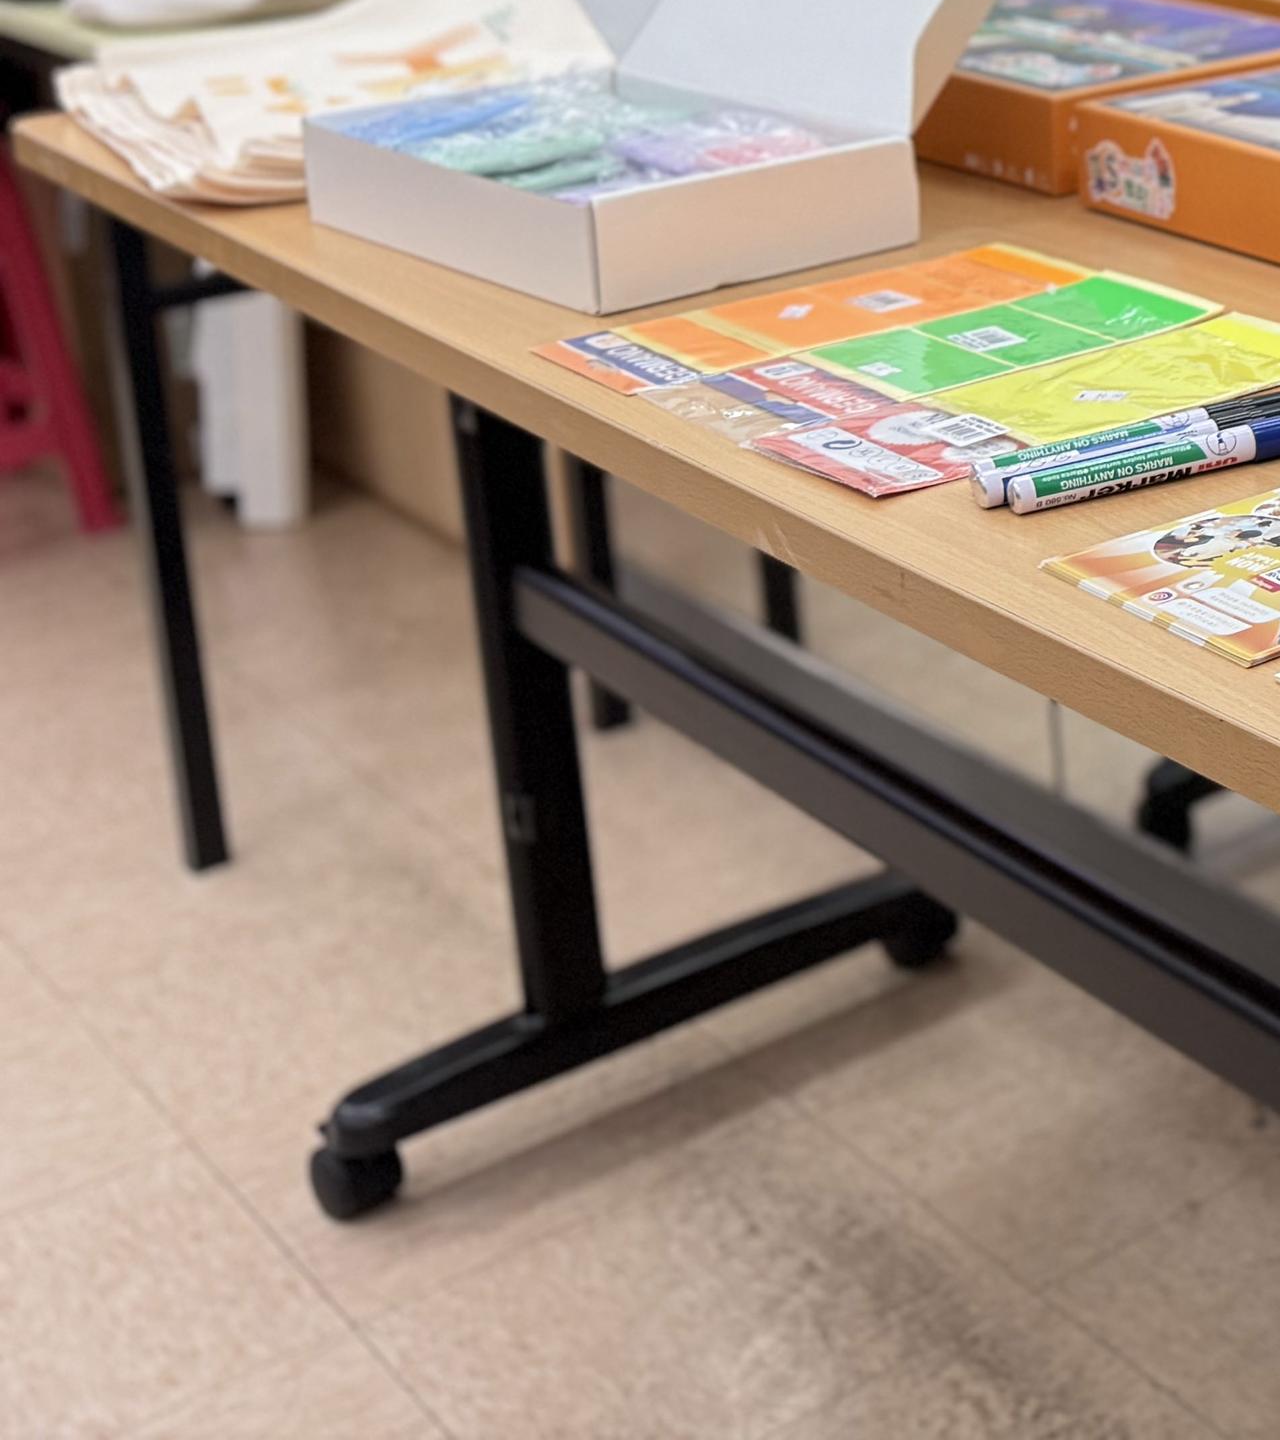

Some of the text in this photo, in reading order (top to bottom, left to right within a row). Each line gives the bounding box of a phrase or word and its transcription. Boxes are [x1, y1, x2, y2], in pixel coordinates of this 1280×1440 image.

[1018, 443, 1071, 461] ANYTHING
[1060, 455, 1174, 490] MARKS ON ANYTHING
